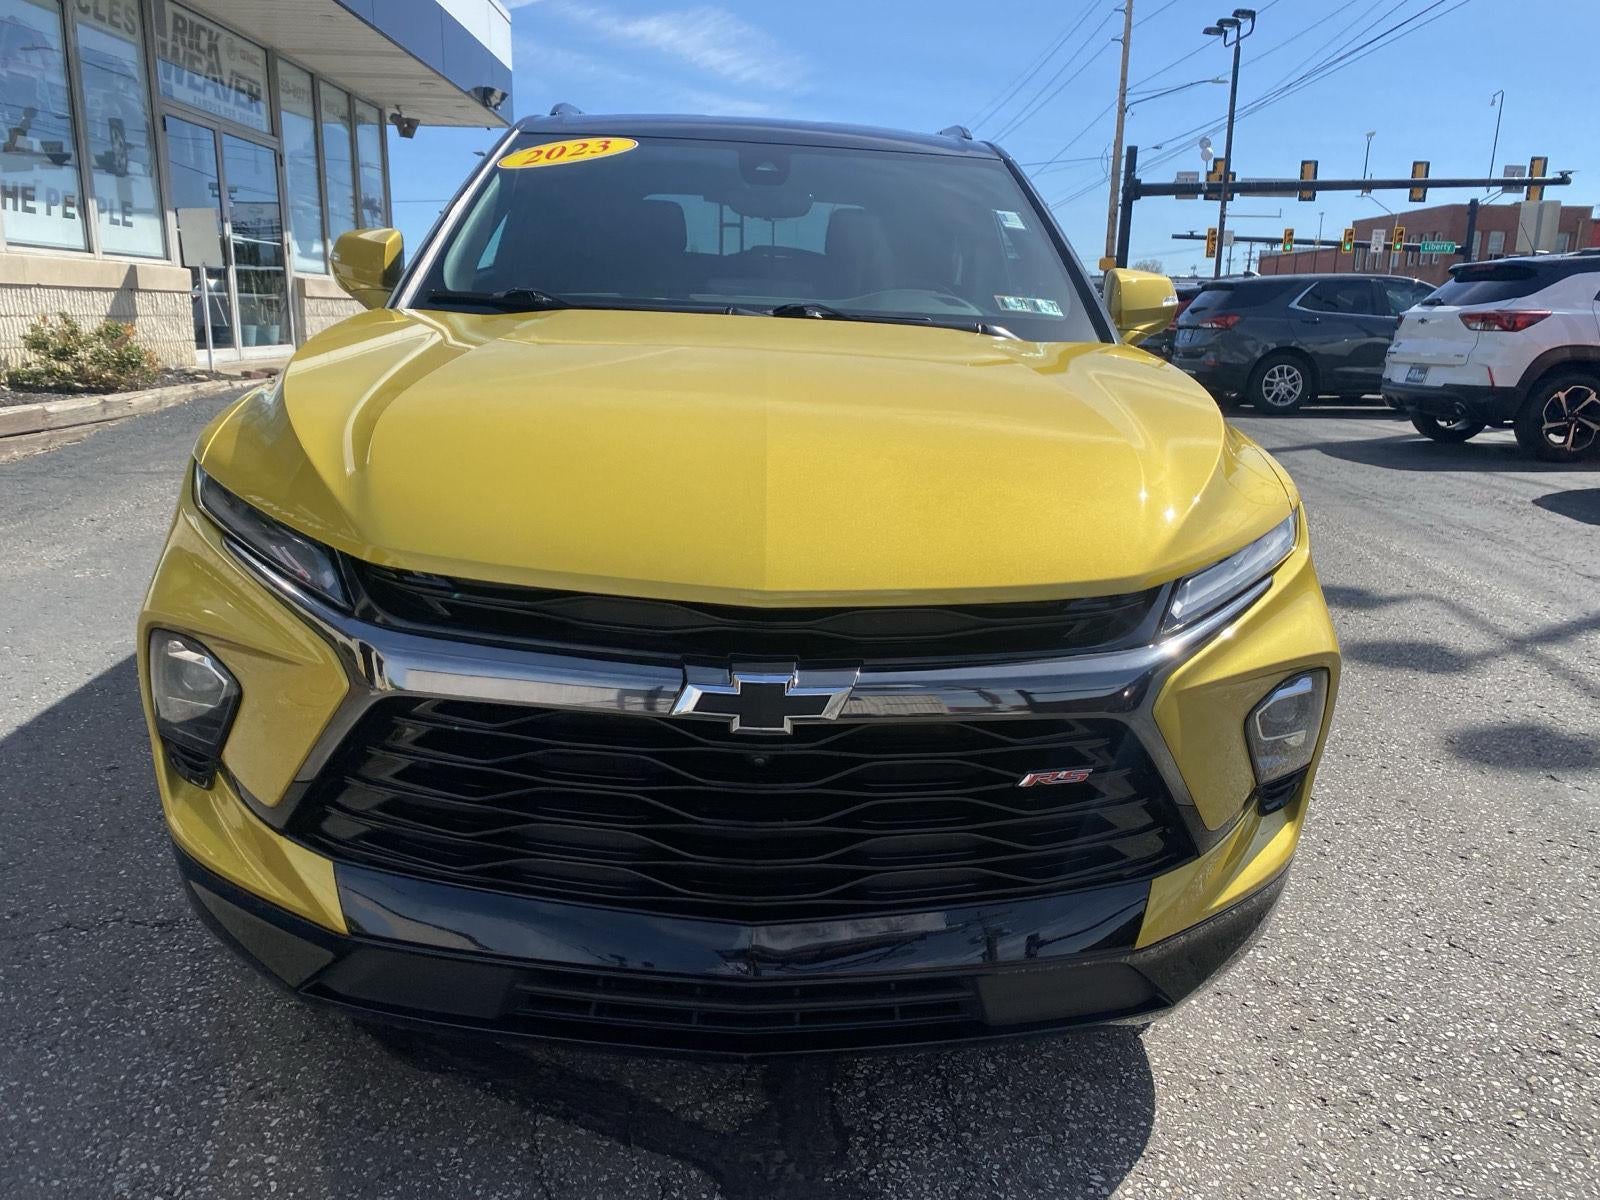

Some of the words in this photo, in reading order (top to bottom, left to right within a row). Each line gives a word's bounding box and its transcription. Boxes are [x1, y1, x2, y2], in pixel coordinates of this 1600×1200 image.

[172, 12, 221, 58] RICK
[160, 39, 263, 116] WEAVER
[522, 140, 611, 165] 2023
[46, 187, 133, 228] PEPLE
[1424, 242, 1452, 251] Liberty
[1019, 768, 1093, 788] RS
